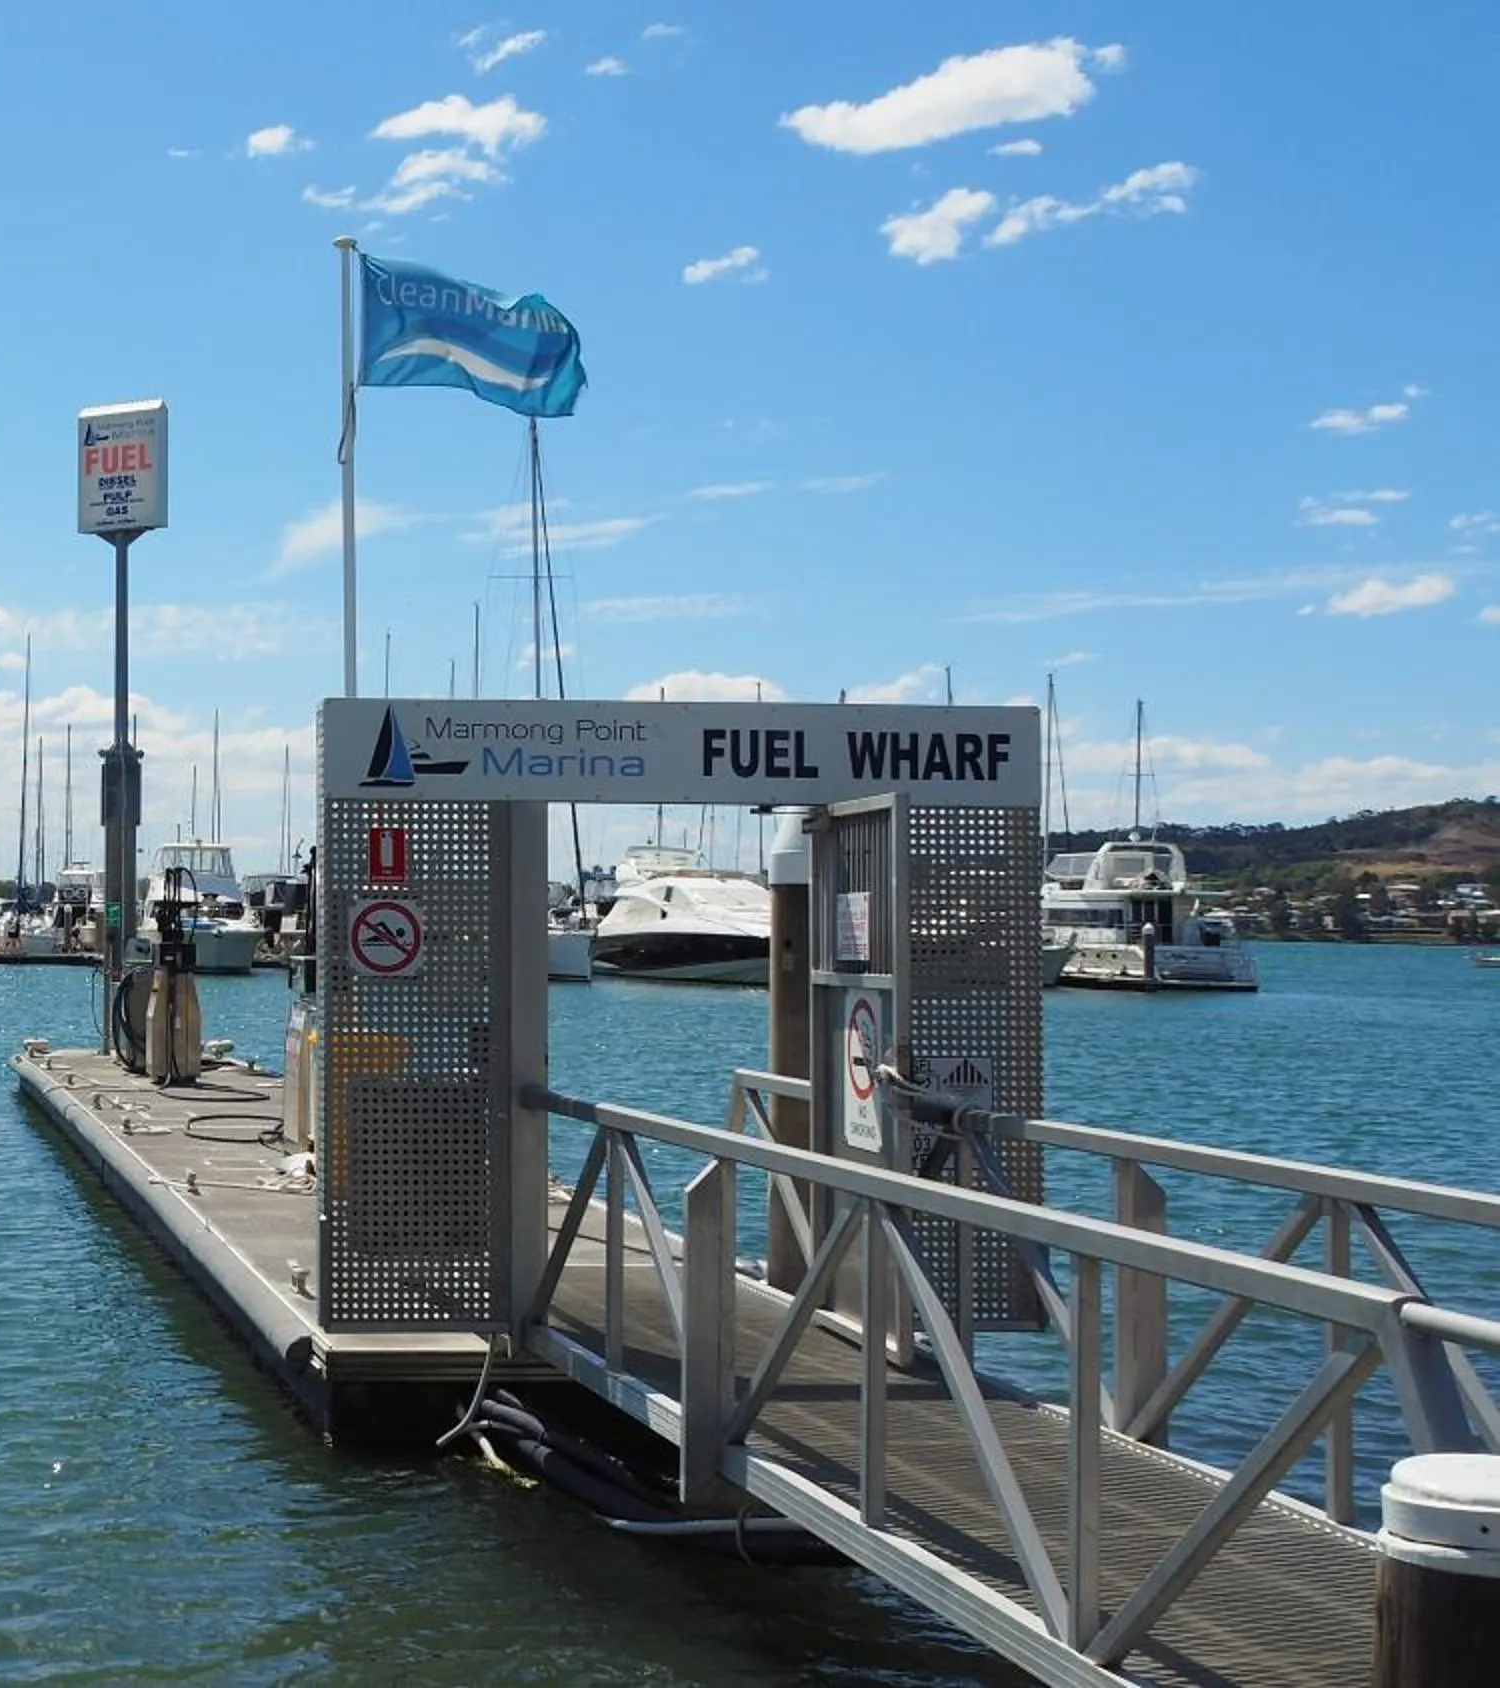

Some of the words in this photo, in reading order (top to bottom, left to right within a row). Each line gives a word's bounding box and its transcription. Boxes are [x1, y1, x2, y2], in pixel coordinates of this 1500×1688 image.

[84, 443, 153, 476] FUEL
[98, 474, 137, 490] DIESEL
[105, 505, 129, 516] GAS
[424, 716, 564, 745] Marmong
[576, 719, 648, 742] Point
[482, 746, 646, 778] Marina
[702, 729, 819, 779] FUEL
[847, 731, 1011, 781] WHARF
